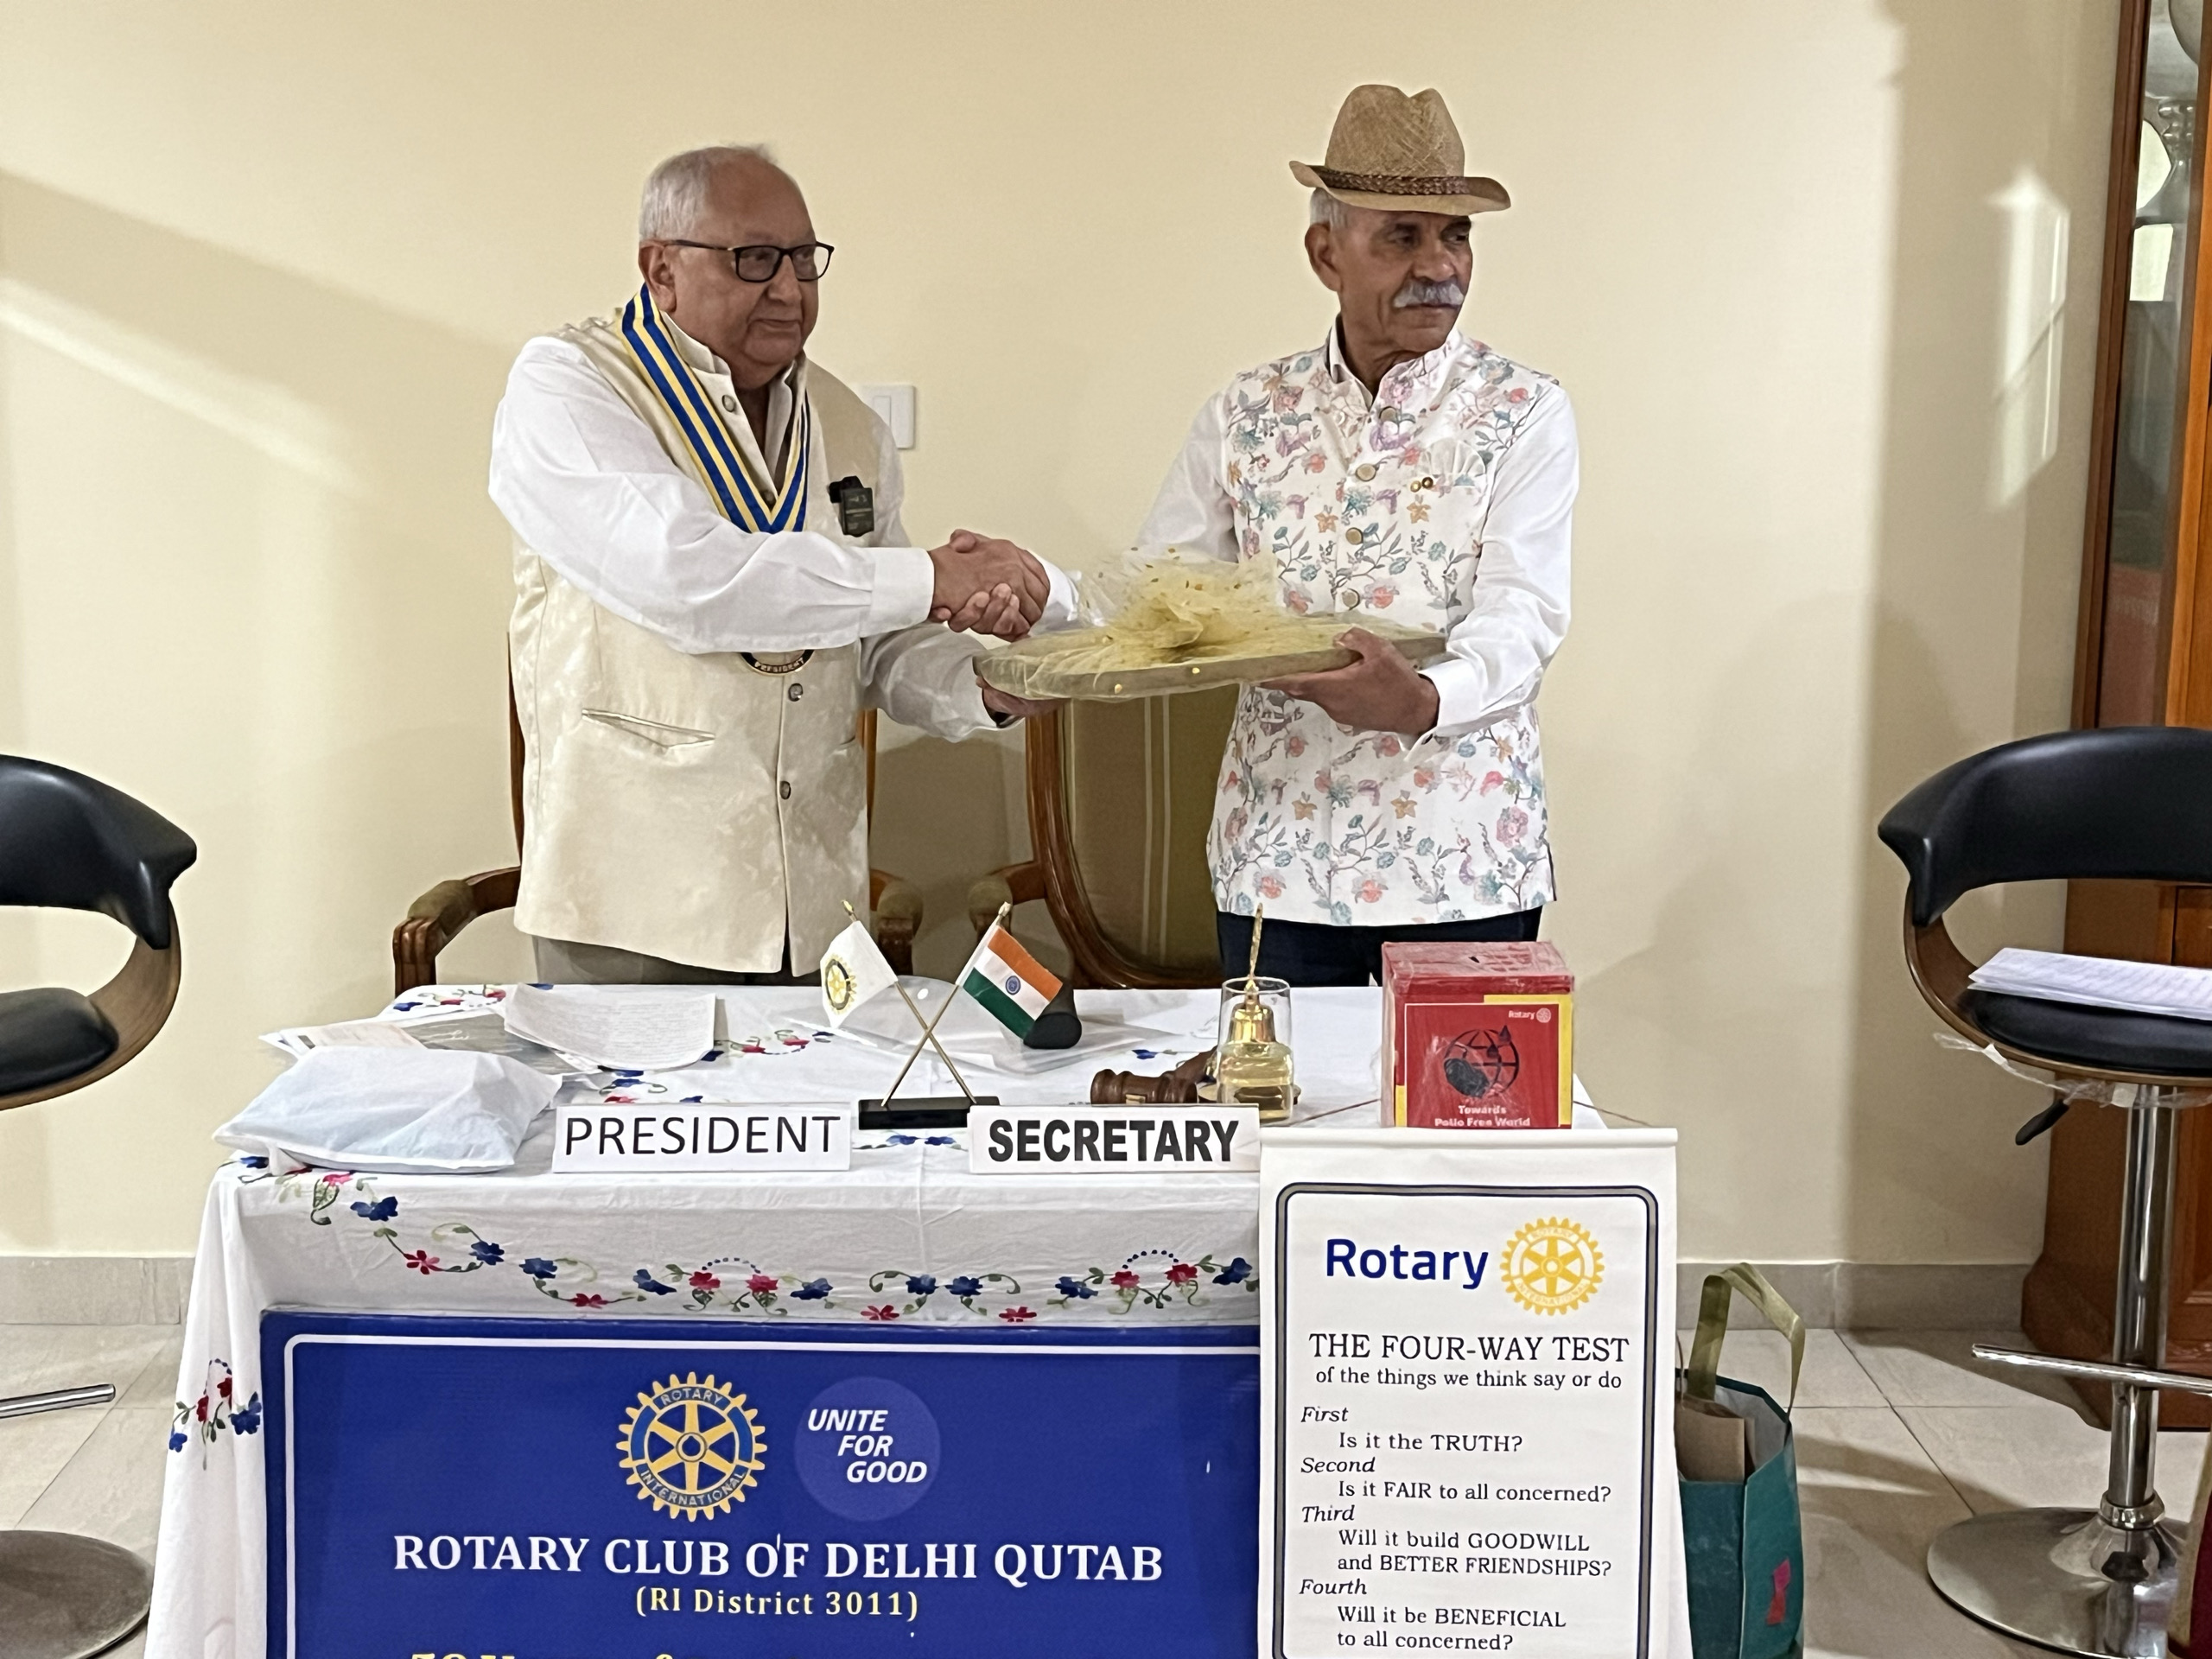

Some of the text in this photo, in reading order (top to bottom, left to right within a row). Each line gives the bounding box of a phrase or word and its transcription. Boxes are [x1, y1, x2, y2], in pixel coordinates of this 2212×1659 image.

[1459, 1105, 1506, 1114] Towards
[1495, 1117, 1530, 1126] World
[565, 1116, 841, 1156] PRESIDENT
[988, 1119, 1239, 1162] SECRETARY
[1326, 1238, 1489, 1290] Rotary
[1308, 1333, 1630, 1363] THE FOUR-WAY TEST
[1316, 1365, 1622, 1391] of the things we think say or do
[660, 1389, 724, 1405] ROTARY
[807, 1408, 889, 1432] UNITE
[1300, 1406, 1349, 1423] First
[837, 1434, 893, 1457] FOR
[1339, 1432, 1522, 1452] Is it the TRUTH?
[846, 1460, 928, 1484] GOOD
[1300, 1456, 1376, 1474] Second
[640, 1470, 745, 1505] INTERNATIONAL
[1338, 1480, 1611, 1503] Is it FAIR to all concerned?
[1301, 1504, 1356, 1523] Third
[1338, 1529, 1590, 1552] Will it build GOODWILL
[393, 1535, 1162, 1588] ROTARY CLUB OF DELHI QUTAB
[1338, 1554, 1611, 1577] and BETTER FRIENDSHIPS?
[1299, 1578, 1368, 1595] Fourth
[636, 1586, 918, 1622] (RI District 3011)
[1337, 1605, 1567, 1628] Will it be BENEFICIAL
[1337, 1630, 1513, 1650] to all concerned?
